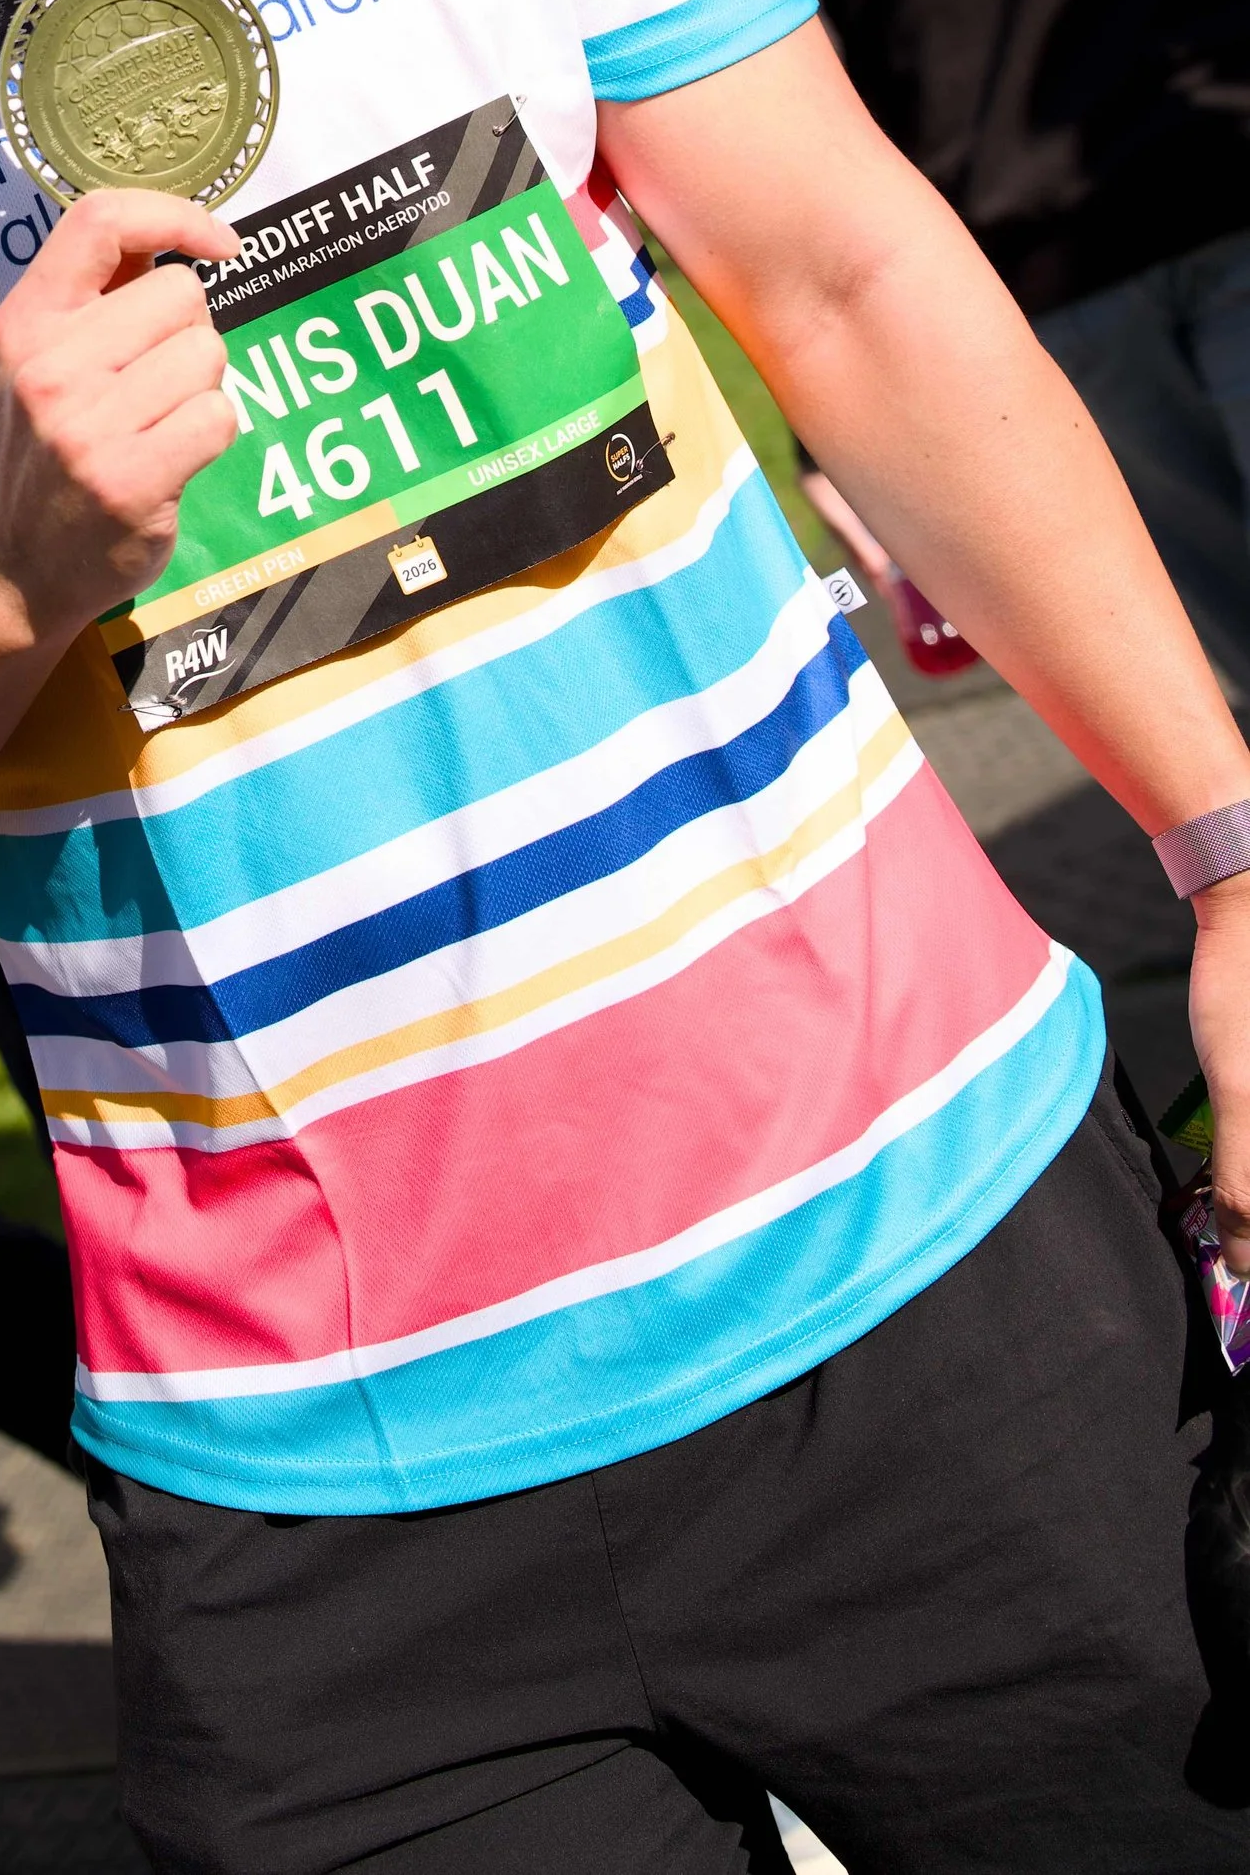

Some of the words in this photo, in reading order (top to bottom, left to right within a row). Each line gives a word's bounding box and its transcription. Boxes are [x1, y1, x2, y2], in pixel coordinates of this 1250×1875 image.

[69, 55, 144, 104] CARDIFF
[147, 32, 196, 63] HALF
[77, 66, 161, 117] MARATHON
[166, 47, 201, 73] 2026
[191, 200, 334, 289] CARDIFF
[339, 151, 436, 222] HALF
[206, 272, 273, 314] HANNER
[273, 233, 363, 283] MARATHON
[365, 191, 451, 240] CAERDYDD
[221, 315, 359, 435] NIS
[359, 212, 570, 365] DUAN
[256, 368, 478, 522] 4611
[466, 447, 544, 490] UNISEX
[546, 409, 602, 457] LARGE
[610, 445, 629, 463] SUPER
[612, 453, 631, 471] HALFS
[194, 567, 262, 608] GREEN
[264, 546, 306, 577] PEN
[402, 558, 438, 583] 2026
[165, 628, 228, 684] R4W
